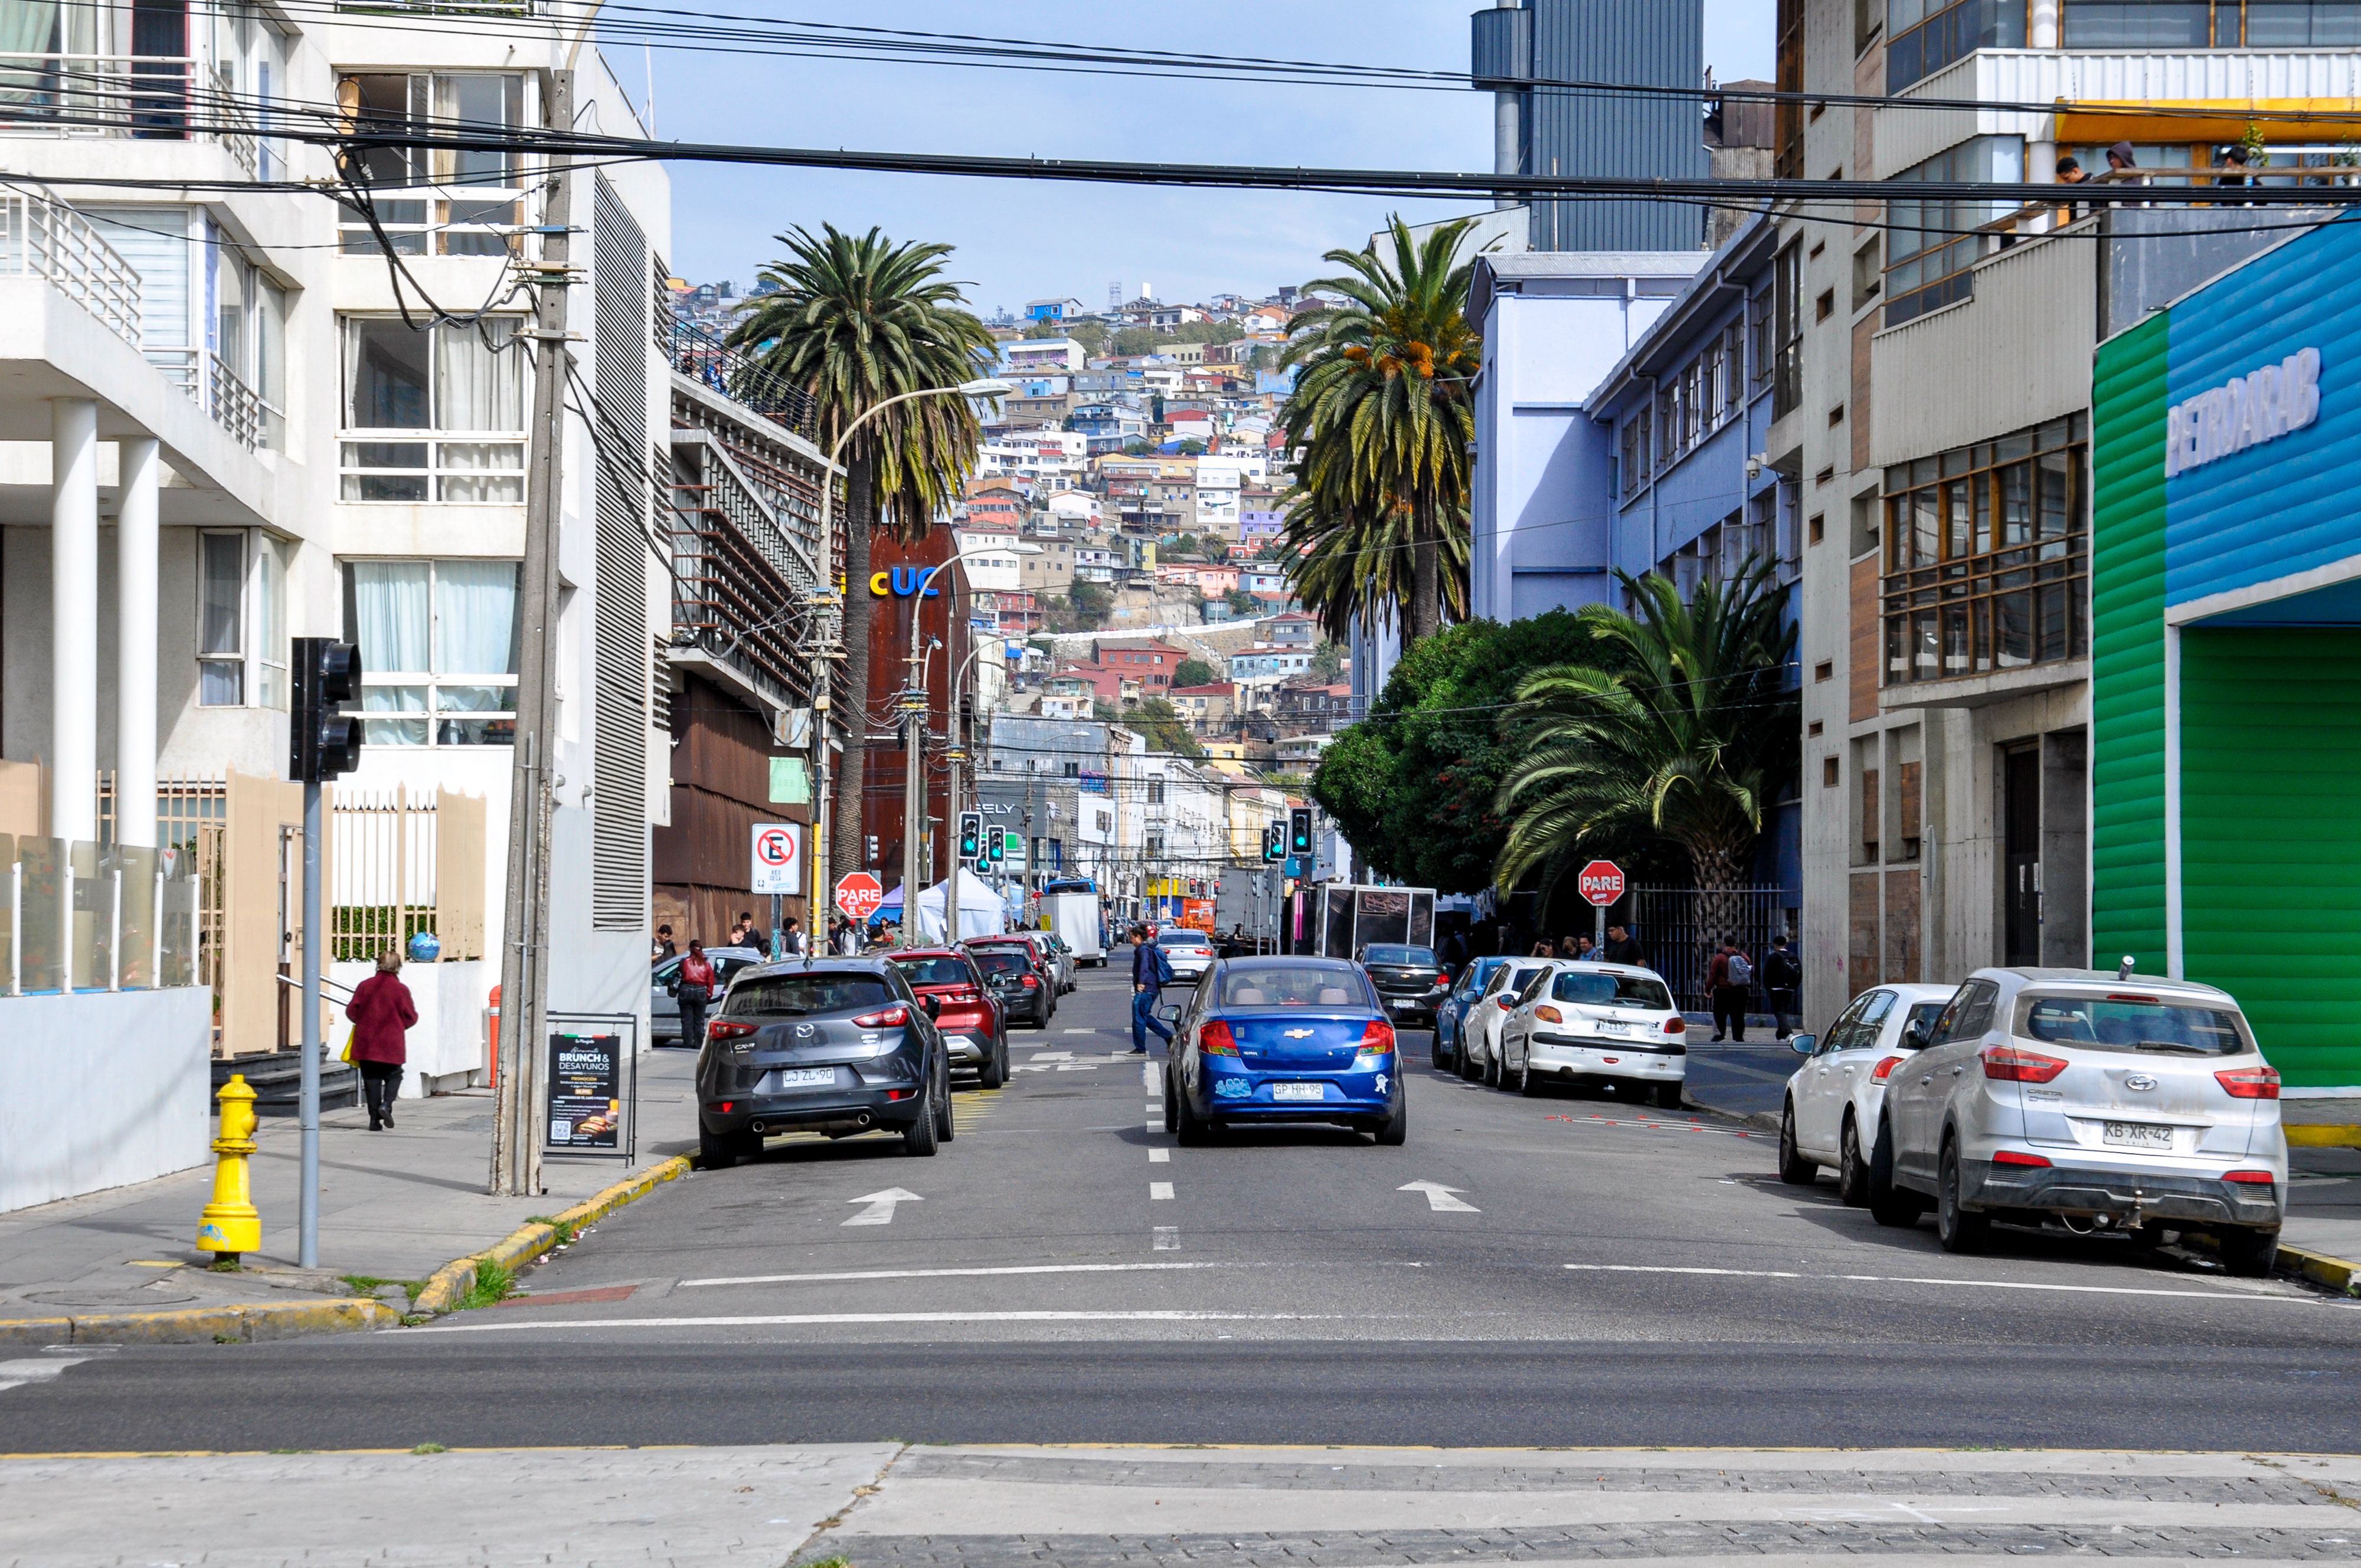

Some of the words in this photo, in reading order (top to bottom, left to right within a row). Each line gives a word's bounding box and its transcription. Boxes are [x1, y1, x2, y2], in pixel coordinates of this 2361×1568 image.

[1582, 876, 1621, 891] PARE
[838, 889, 880, 902] PARE
[559, 1053, 601, 1062] BRUNCH
[602, 1054, 609, 1062] &
[559, 1062, 609, 1071] DESAYUNOS
